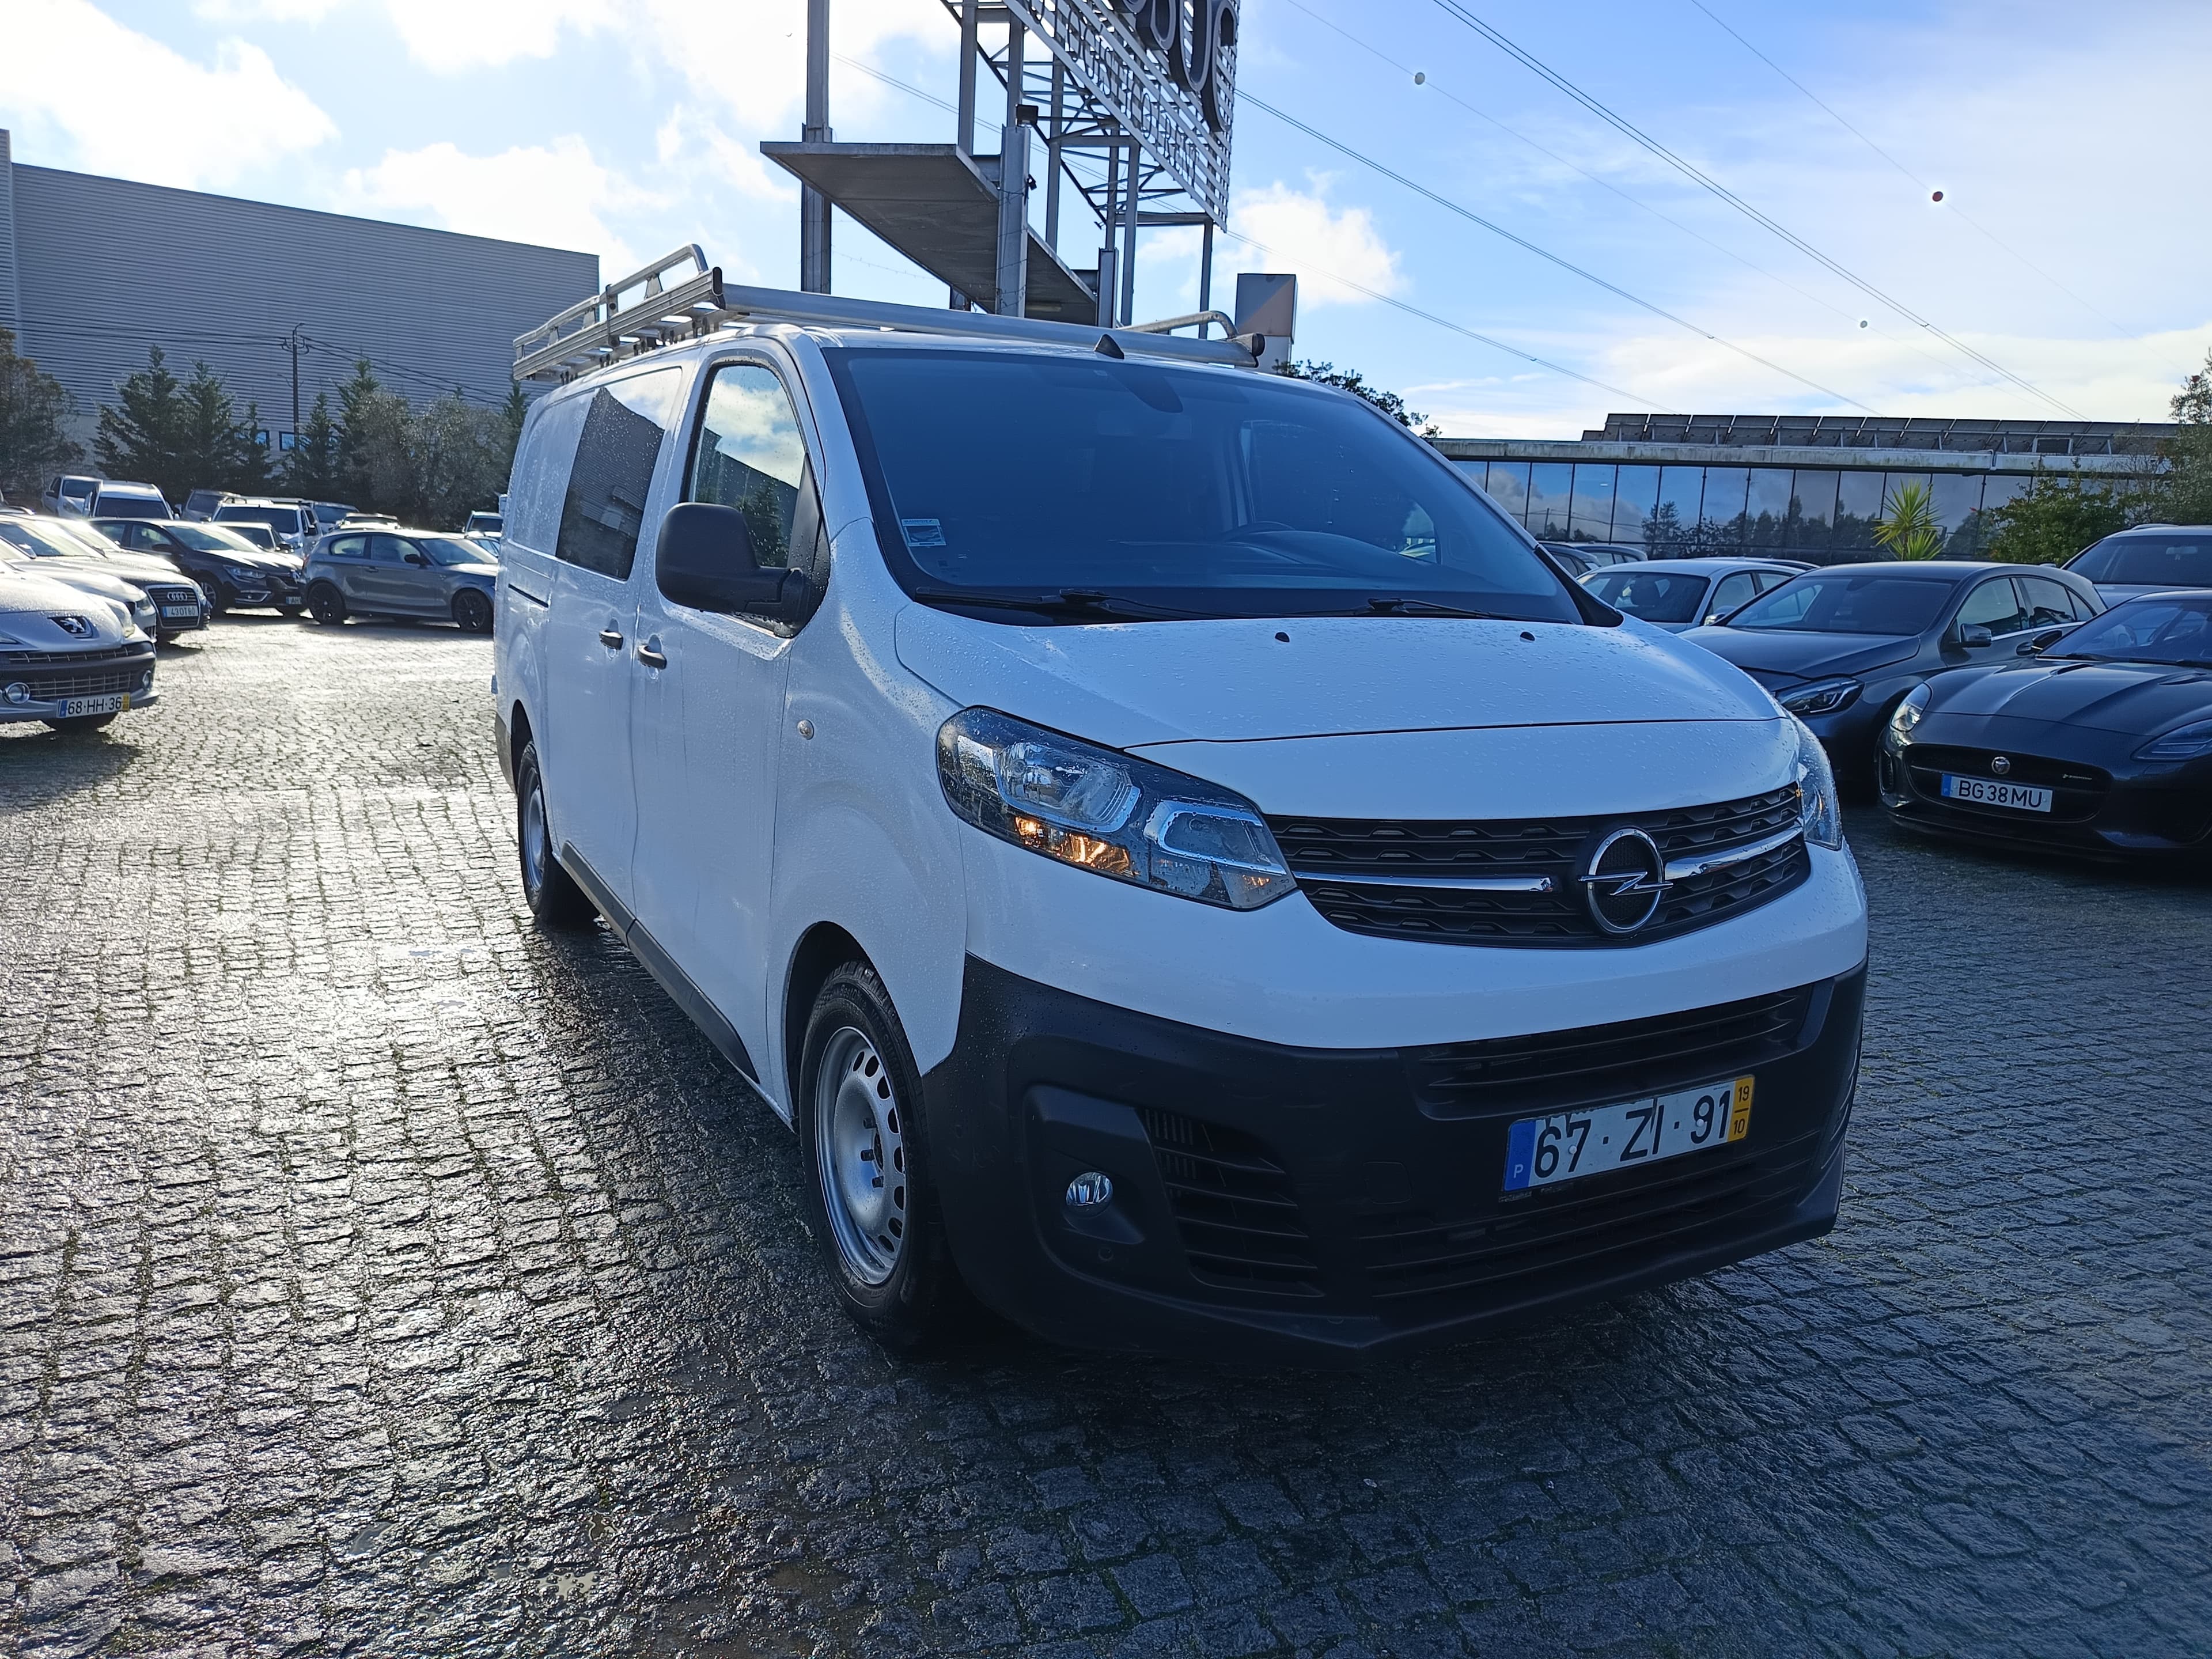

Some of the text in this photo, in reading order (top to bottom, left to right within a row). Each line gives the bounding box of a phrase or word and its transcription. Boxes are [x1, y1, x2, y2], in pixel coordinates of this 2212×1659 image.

[1738, 1085, 1750, 1102] 19
[1733, 1118, 1745, 1135] 10
[1514, 1163, 1524, 1179] P
